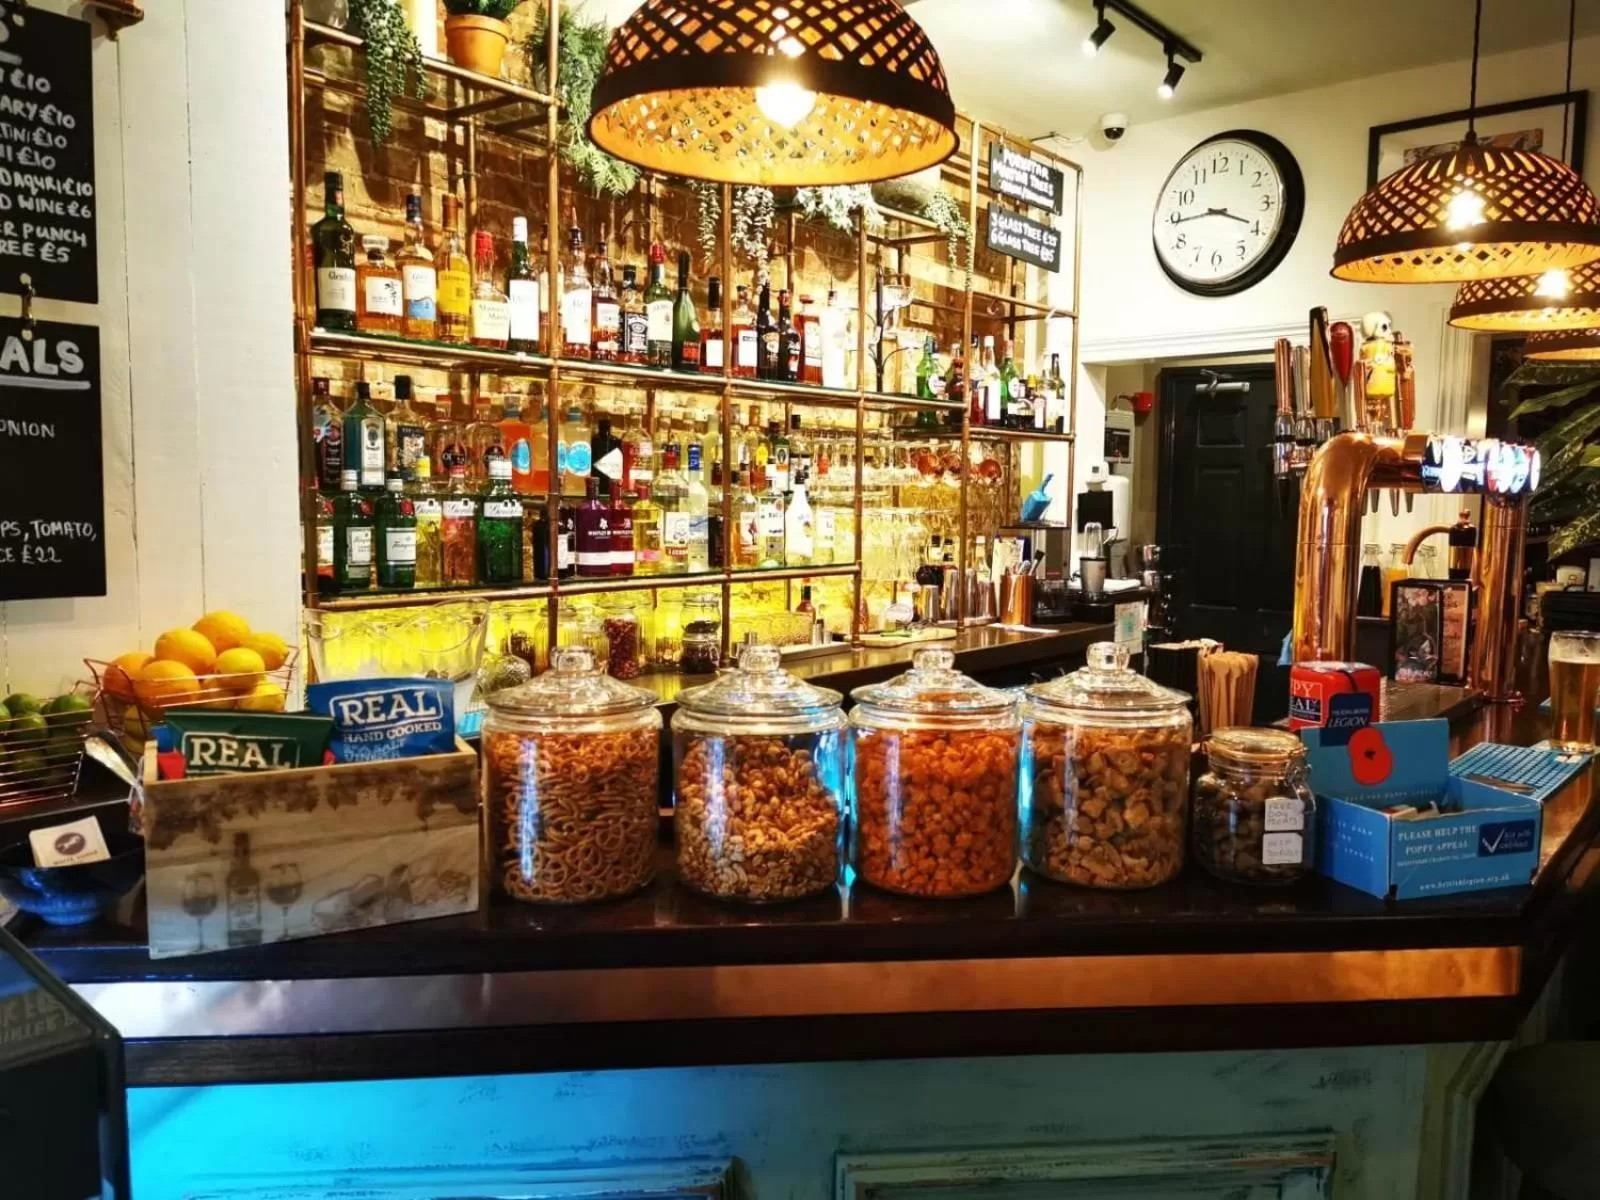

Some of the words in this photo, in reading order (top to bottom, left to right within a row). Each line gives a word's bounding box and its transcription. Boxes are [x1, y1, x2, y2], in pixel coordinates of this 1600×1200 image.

[10, 68, 51, 93] £10
[39, 104, 76, 129] £10
[32, 127, 68, 149] £10
[16, 146, 56, 171] £10
[1213, 156, 1229, 174] 12
[1239, 159, 1244, 175] 1
[1194, 168, 1206, 185] 11
[1251, 171, 1262, 188] 2
[17, 194, 66, 216] WINE
[67, 201, 92, 218] £6
[1178, 189, 1195, 206] 10
[1261, 194, 1270, 211] 3
[1170, 211, 1181, 224] 9
[22, 222, 88, 248] PUNCH
[1250, 220, 1260, 236] 4
[1176, 233, 1186, 250] 8
[1236, 240, 1246, 256] 5
[39, 241, 71, 263] £5
[1193, 246, 1202, 262] 7
[1211, 250, 1222, 266] 6
[0, 336, 84, 376] ALS
[29, 519, 97, 542] TOMATO,
[21, 543, 62, 564] £22
[338, 691, 437, 726] REAL
[343, 730, 384, 743] HAND
[386, 721, 442, 740] COOKED
[190, 737, 291, 769] REAL
[1398, 830, 1432, 841] PLEASE
[1434, 826, 1459, 838] HELP
[1459, 824, 1478, 835] THE
[1406, 844, 1433, 855] POPPY
[1435, 840, 1468, 851] APPEAL
